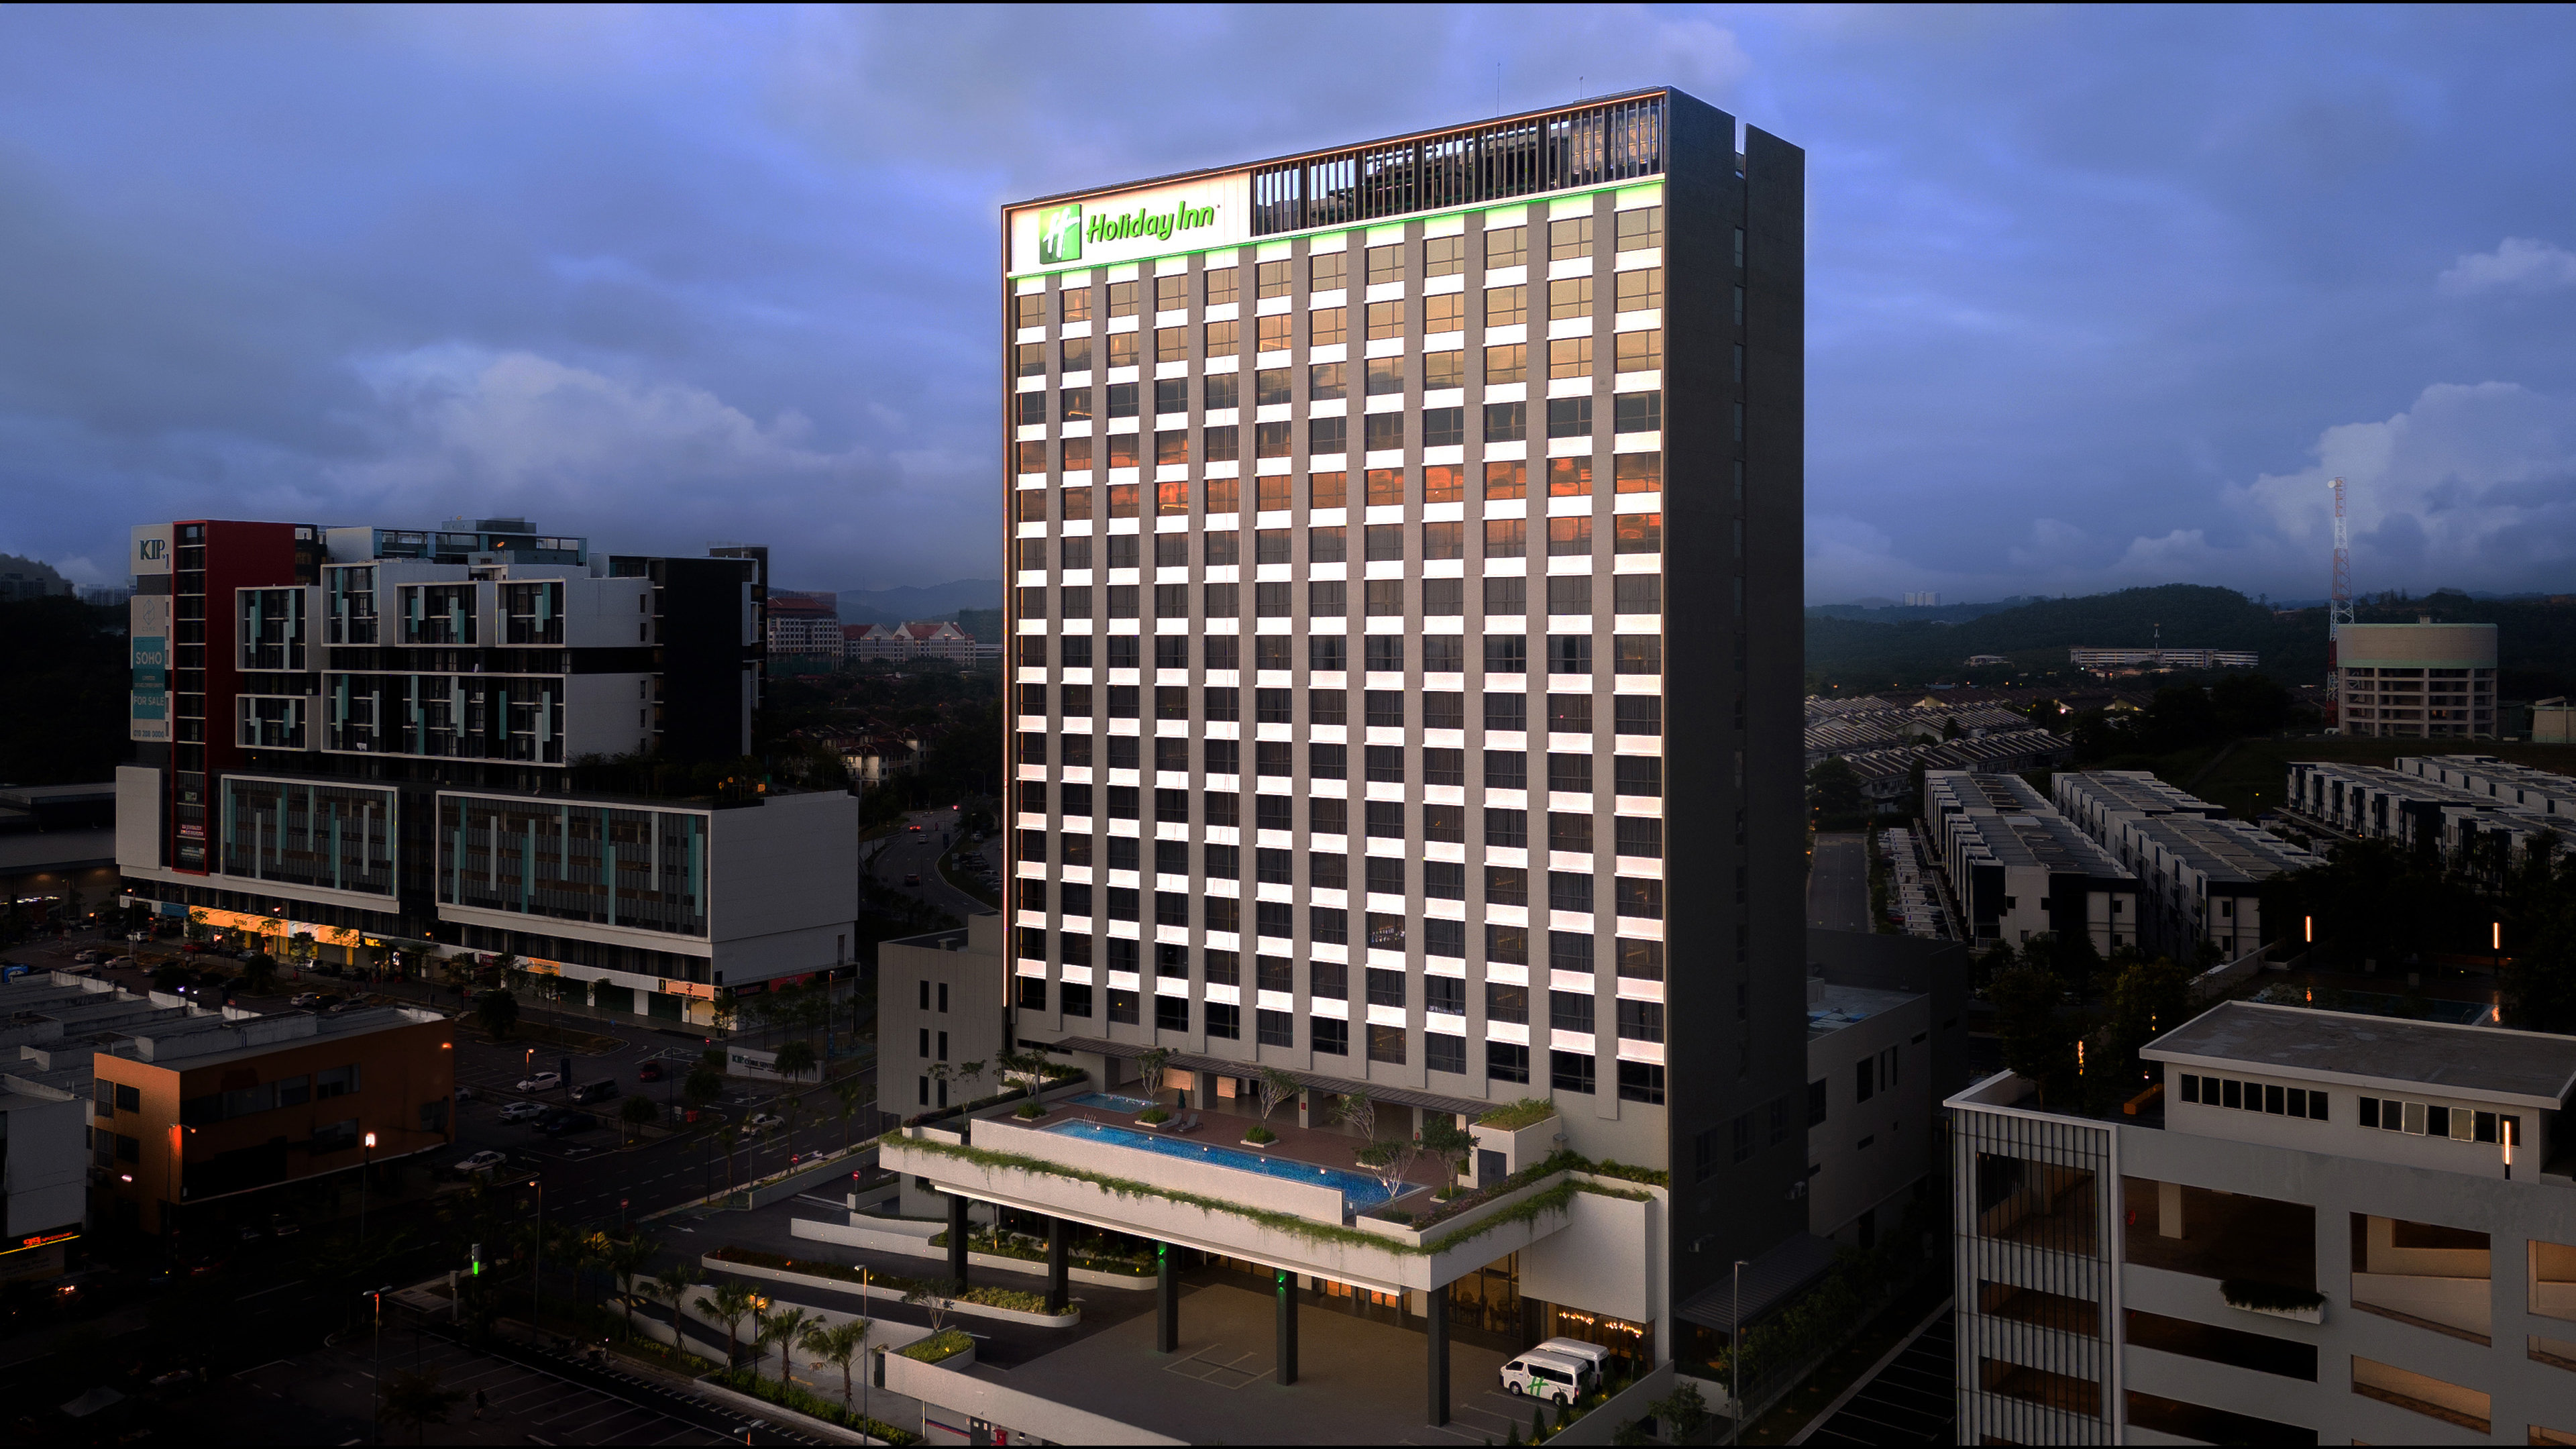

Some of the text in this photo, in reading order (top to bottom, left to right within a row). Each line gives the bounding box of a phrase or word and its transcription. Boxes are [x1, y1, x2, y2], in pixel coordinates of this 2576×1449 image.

[1086, 208, 1173, 242] Holiday
[1176, 201, 1214, 230] Inn
[136, 651, 162, 665] SOHO
[133, 696, 164, 706] FOR SALE
[23, 1236, 42, 1248] 99
